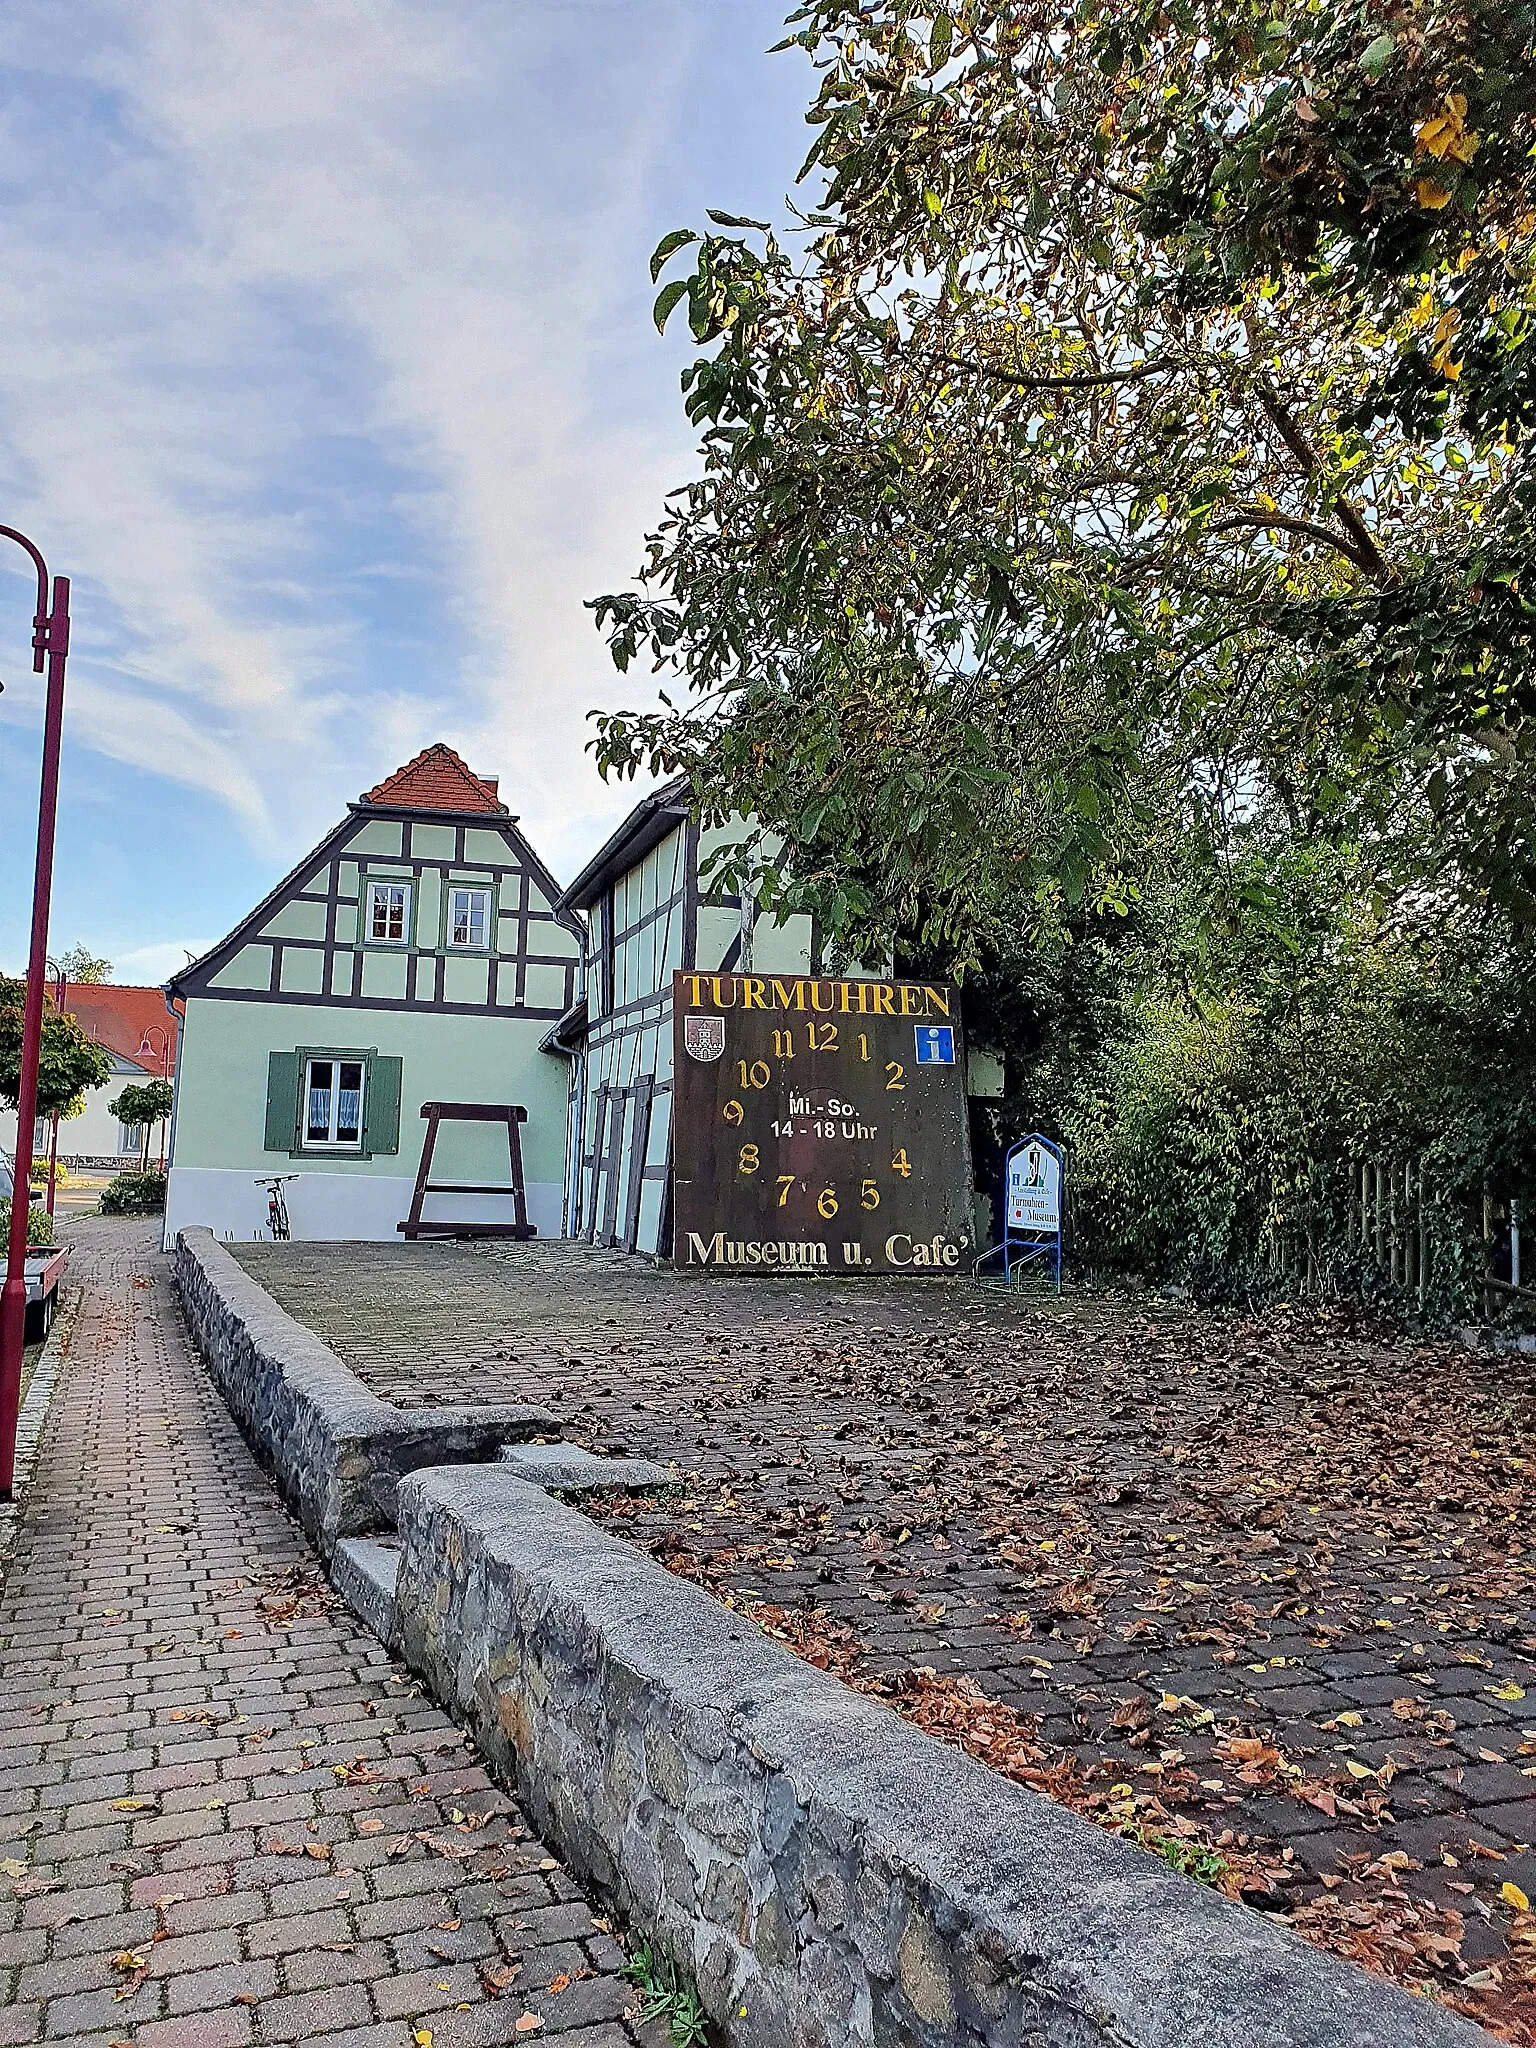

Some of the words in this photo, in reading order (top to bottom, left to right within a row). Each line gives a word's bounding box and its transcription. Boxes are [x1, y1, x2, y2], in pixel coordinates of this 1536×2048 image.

[682, 975, 951, 1017] TURMUHREN
[772, 1029, 796, 1059] 11
[805, 1021, 839, 1052] 12
[857, 1033, 871, 1062] 1
[927, 1028, 945, 1061] i
[737, 1059, 771, 1089] 10
[885, 1061, 905, 1090] 2
[723, 1100, 744, 1126] 9
[770, 1121, 793, 1138] 14
[813, 1121, 836, 1139] 18
[842, 1122, 878, 1140] Uhr
[739, 1144, 759, 1174] 8
[891, 1148, 912, 1178] 4
[776, 1176, 795, 1207] 7
[817, 1188, 839, 1219] 6
[860, 1179, 880, 1211] 5
[685, 1232, 829, 1266] Museum
[842, 1241, 872, 1265] u.
